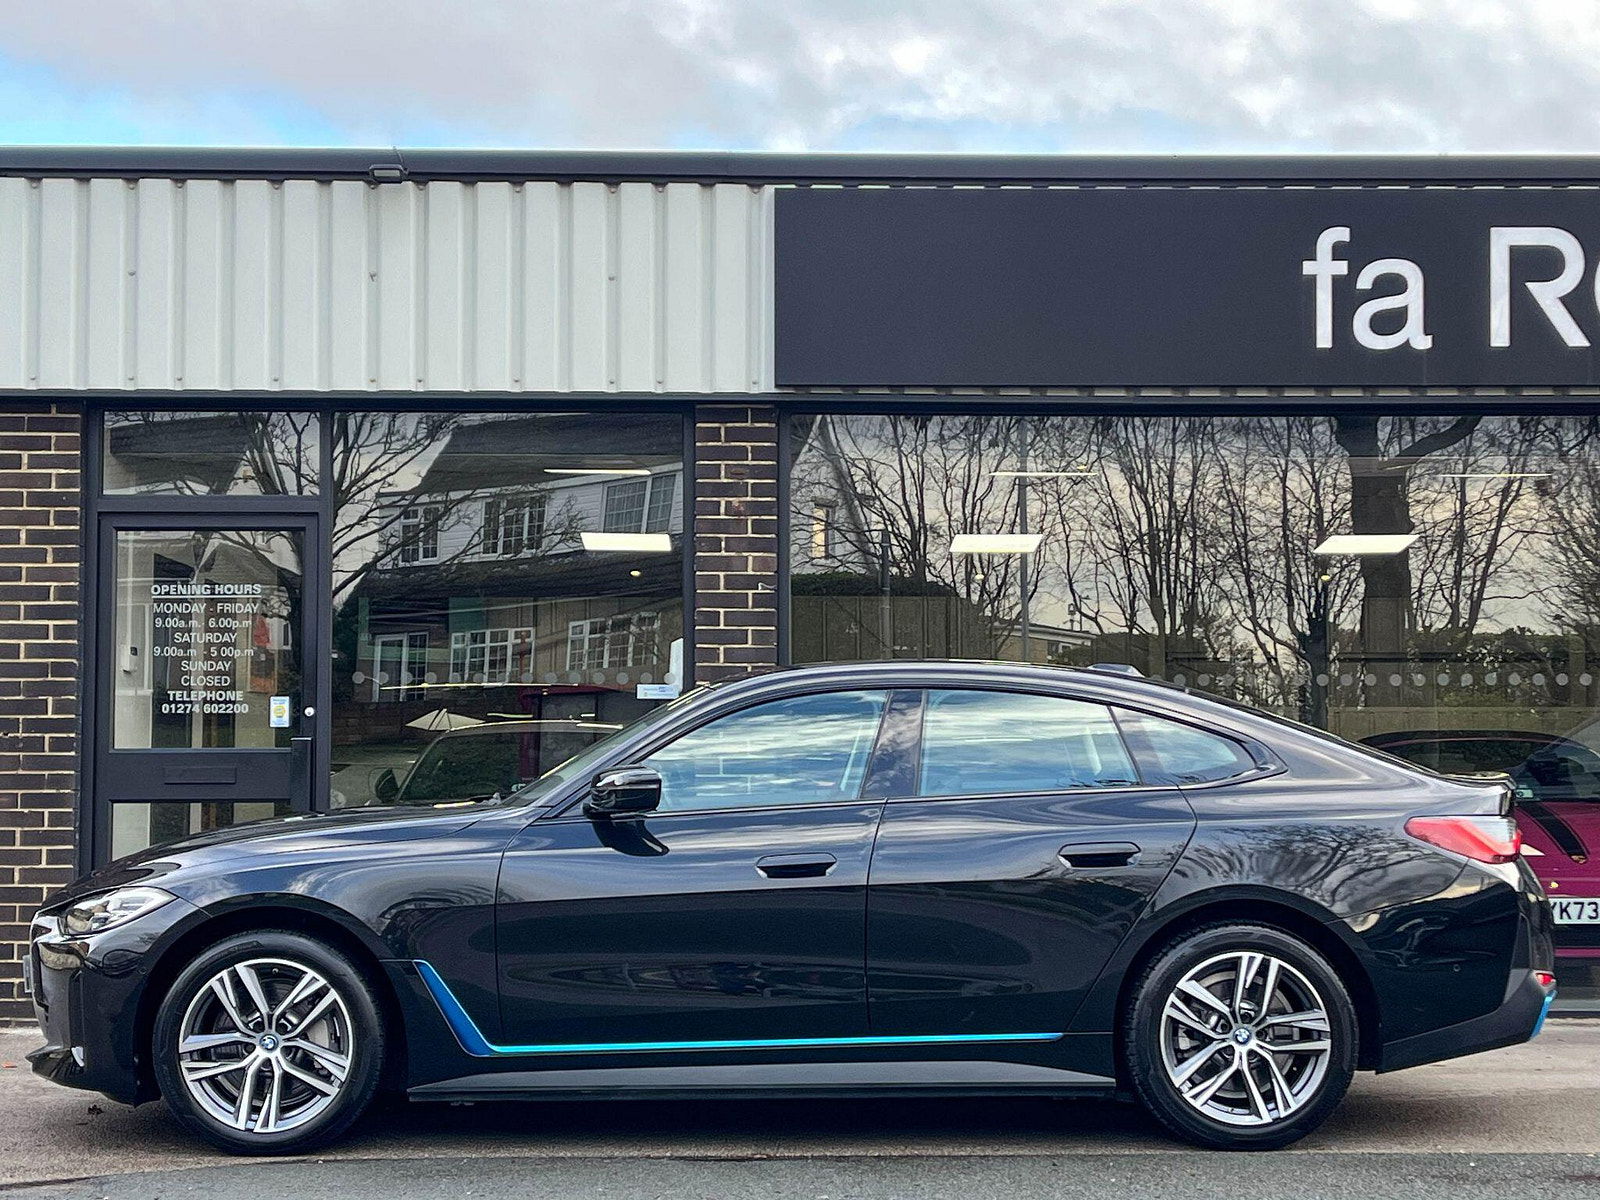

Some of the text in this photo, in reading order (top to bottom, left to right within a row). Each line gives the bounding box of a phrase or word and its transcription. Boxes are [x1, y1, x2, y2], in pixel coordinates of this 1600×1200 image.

[1302, 226, 1600, 350] fa R
[151, 584, 262, 595] OPENING HOURS
[153, 603, 206, 613] MONDAY
[216, 603, 259, 613] FRIDAY
[174, 632, 238, 643] SATURDAY
[181, 660, 232, 671] SUNDAY
[181, 675, 231, 687] CLOSED
[167, 690, 244, 701] TELEPHONE
[161, 703, 249, 714] 01274 602200
